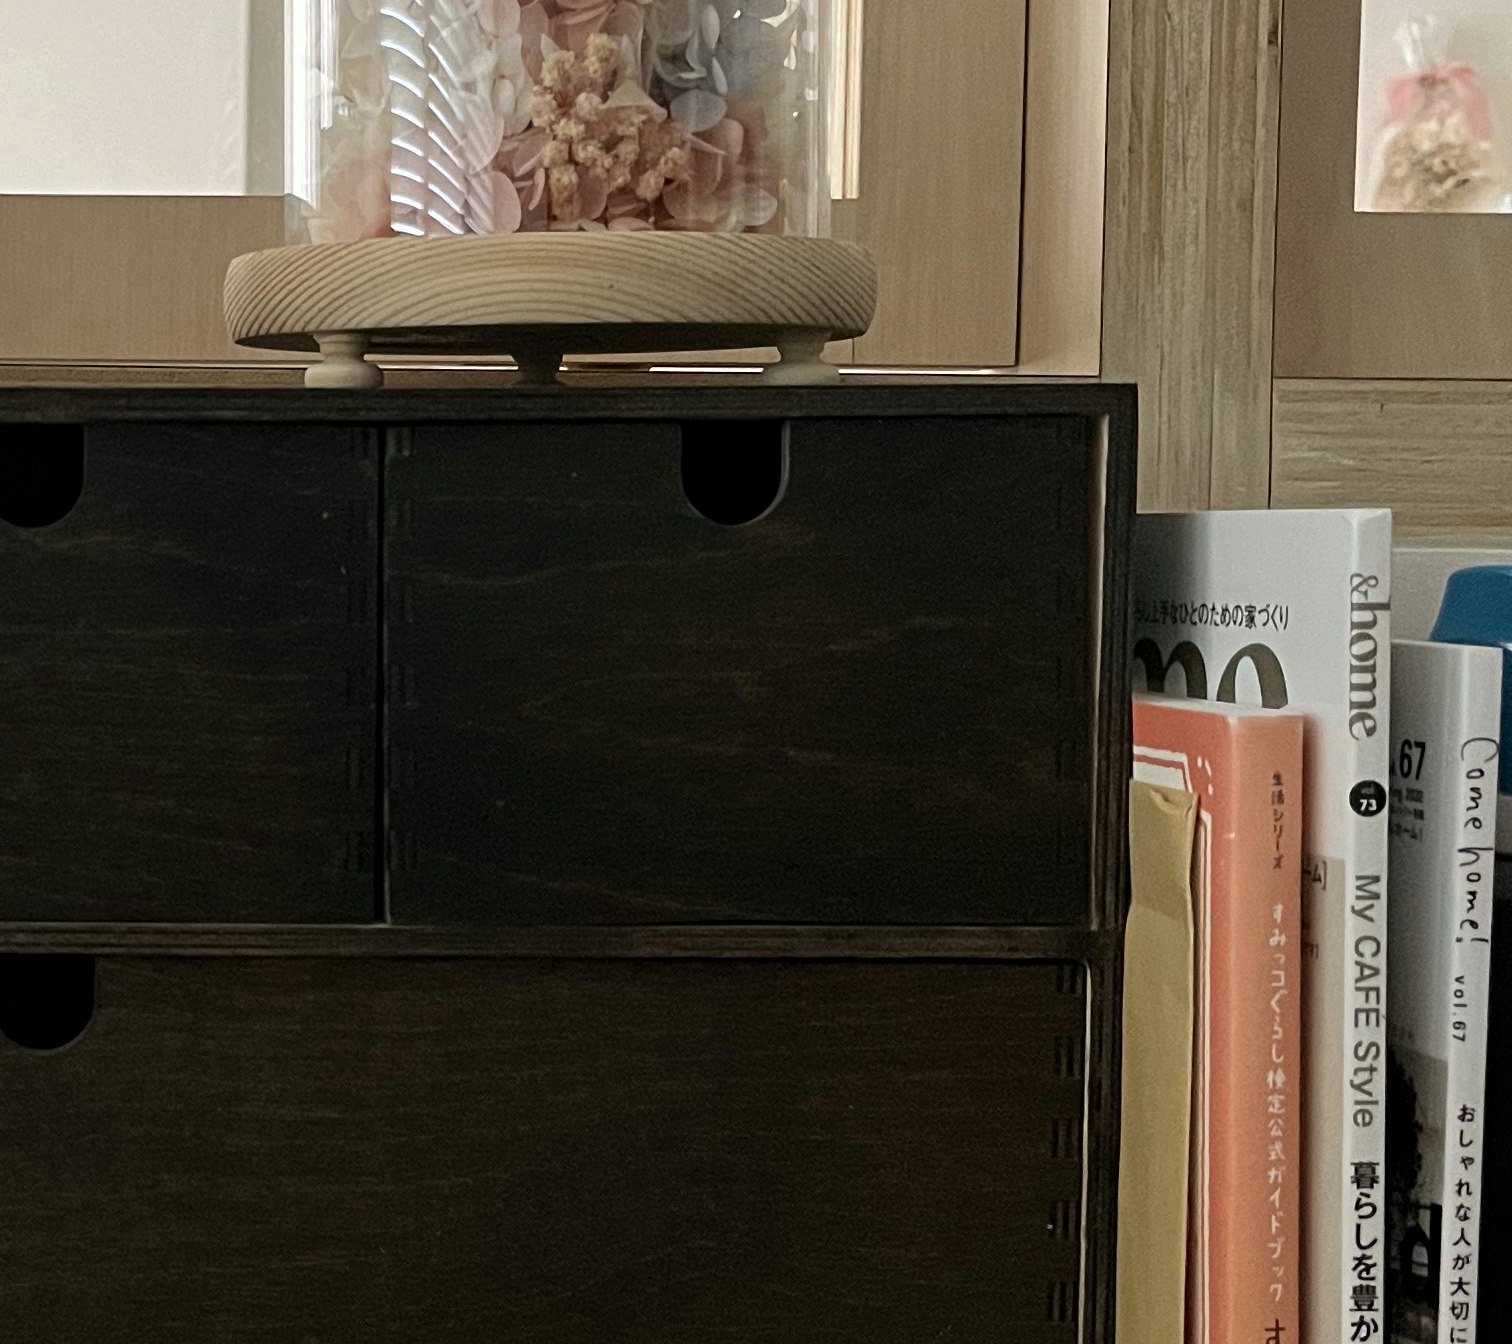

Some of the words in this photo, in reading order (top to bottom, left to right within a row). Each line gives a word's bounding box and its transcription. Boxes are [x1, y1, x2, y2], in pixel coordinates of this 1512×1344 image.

[1348, 572, 1391, 742] &home
[1359, 798, 1377, 812] 73
[1459, 736, 1500, 830] Come
[1350, 874, 1381, 923] My
[1456, 846, 1494, 944] home!
[1354, 934, 1381, 1028] CAFE
[1349, 1040, 1381, 1128] Style
